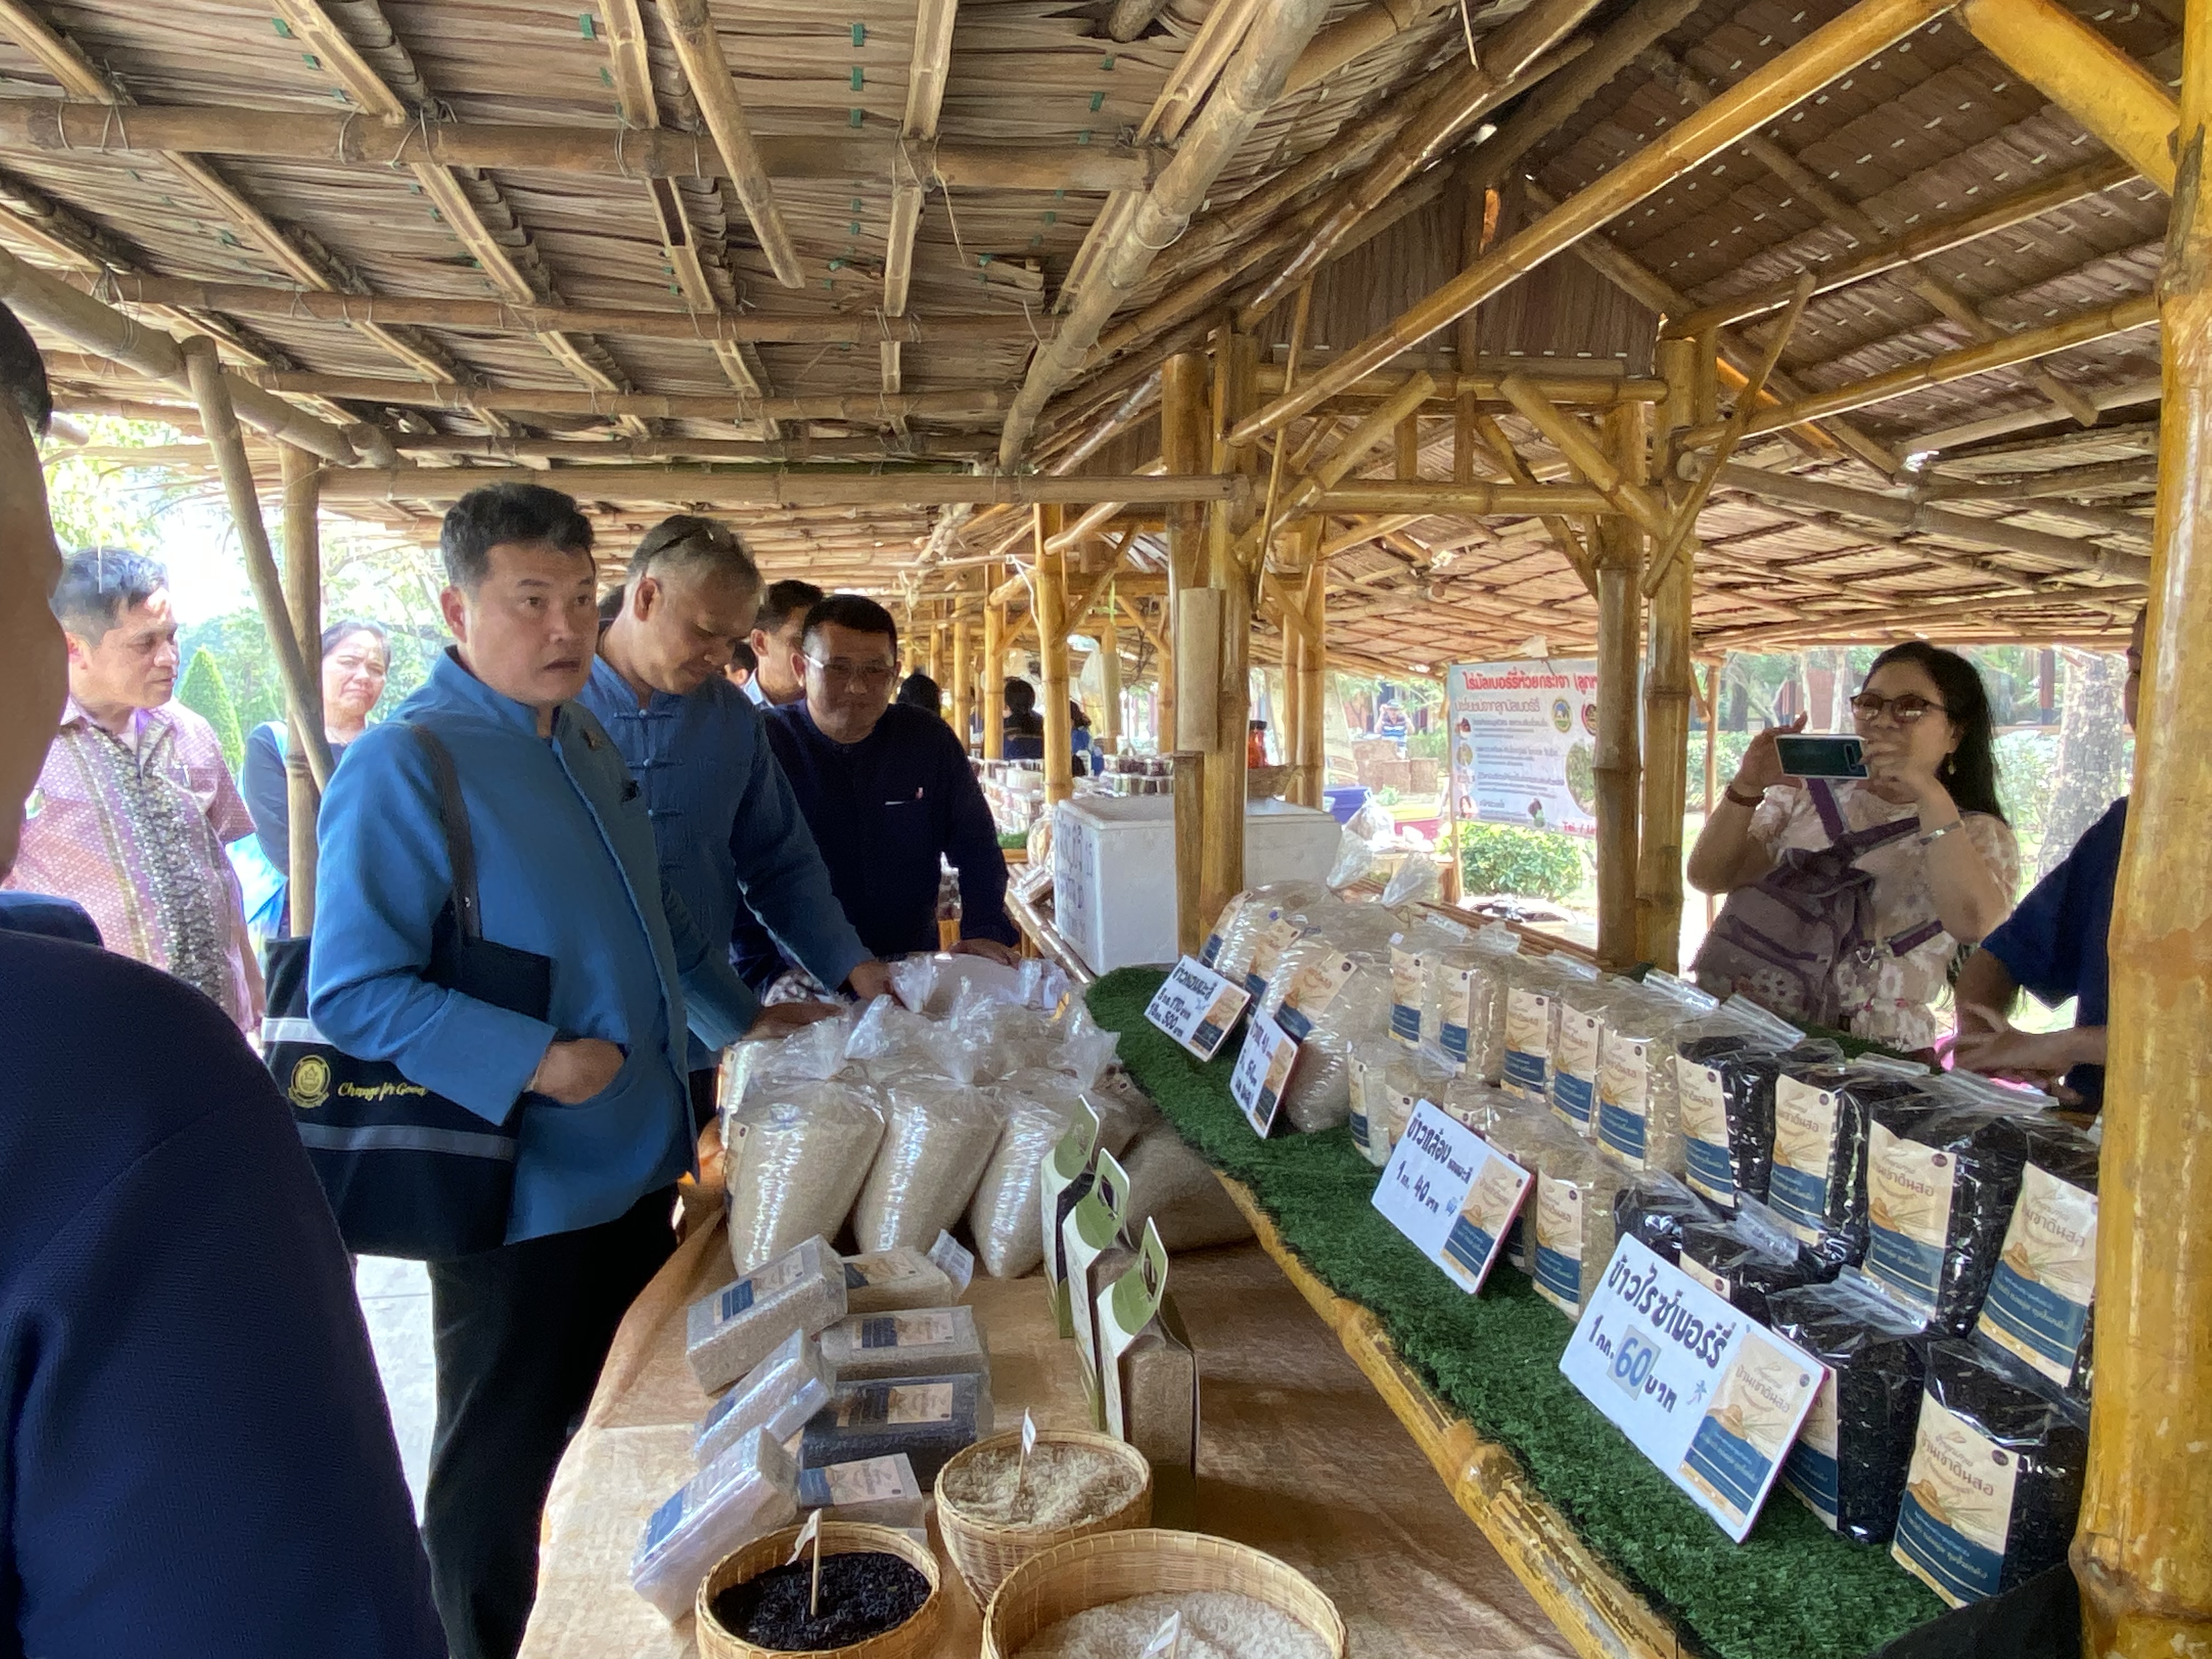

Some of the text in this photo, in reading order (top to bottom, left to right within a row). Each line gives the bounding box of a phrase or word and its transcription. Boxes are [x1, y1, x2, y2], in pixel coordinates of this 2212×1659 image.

[1413, 1174, 1431, 1203] 40
[1607, 1254, 1737, 1369] ข้าวไรซ์เบอร์รี่
[1588, 1314, 1604, 1344] 1
[1614, 1335, 1653, 1389] 60
[1644, 1374, 1678, 1414] บาท
